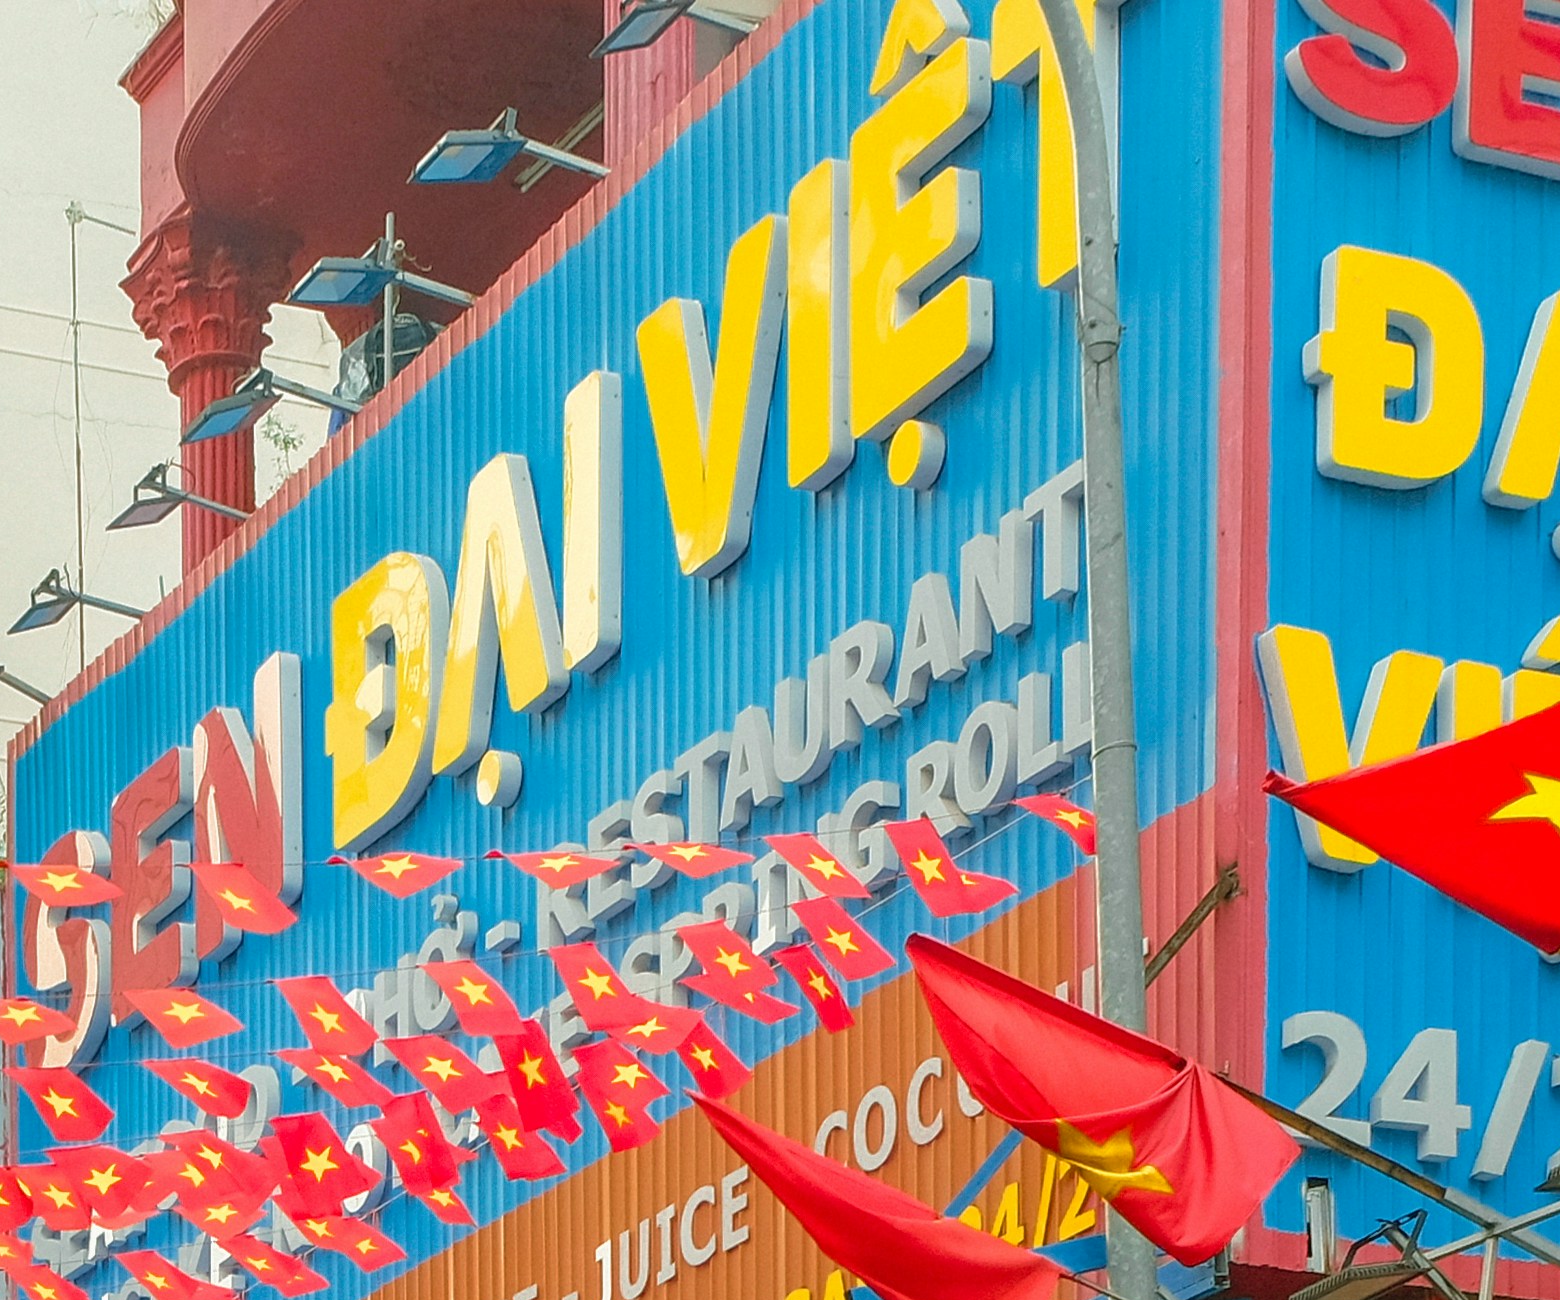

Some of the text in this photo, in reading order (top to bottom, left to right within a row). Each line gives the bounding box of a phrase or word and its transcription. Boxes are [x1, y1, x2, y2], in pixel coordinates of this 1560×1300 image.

[22, 651, 301, 1068] SEN
[324, 371, 622, 853] ĐẠI
[536, 459, 1084, 952] RESTAURANT
